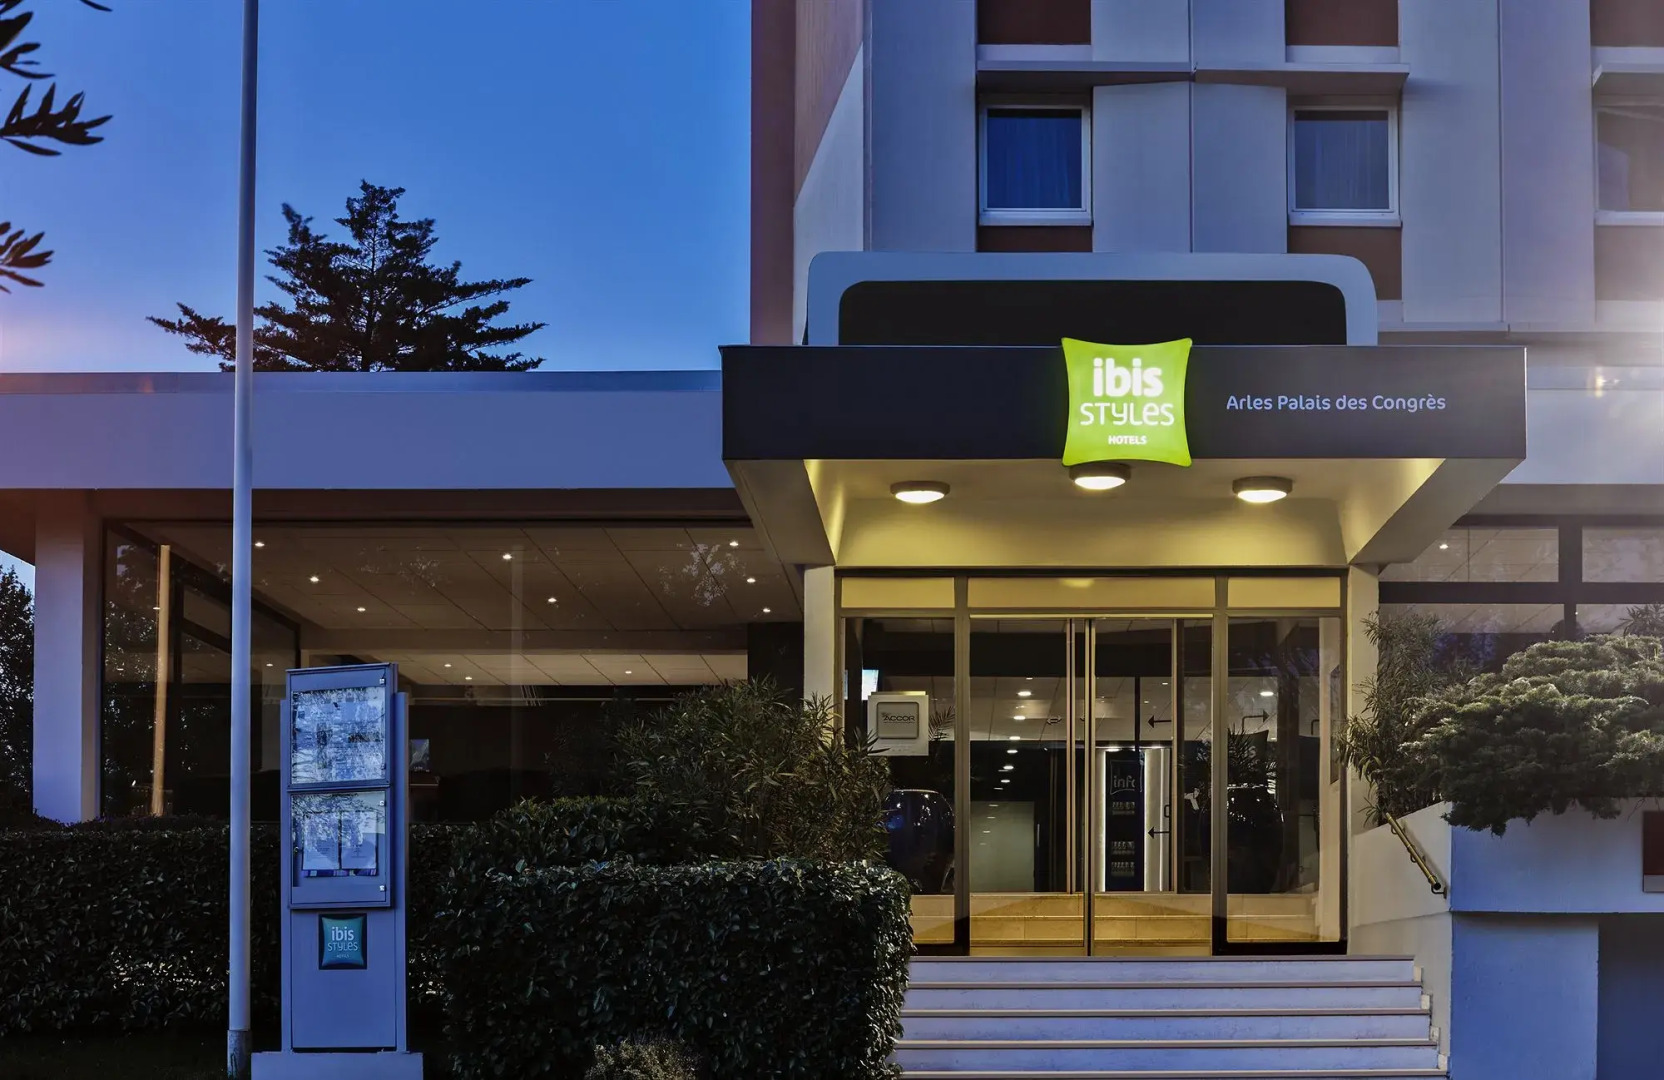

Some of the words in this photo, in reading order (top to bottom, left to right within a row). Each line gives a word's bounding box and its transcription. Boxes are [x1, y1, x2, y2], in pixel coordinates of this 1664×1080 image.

[1093, 358, 1164, 398] ibis
[1226, 394, 1273, 410] Arles
[1277, 394, 1331, 410] Palais
[1335, 394, 1368, 410] des
[1372, 393, 1446, 413] Congrès
[1108, 435, 1147, 445] HOTELS
[331, 926, 355, 941] ibis
